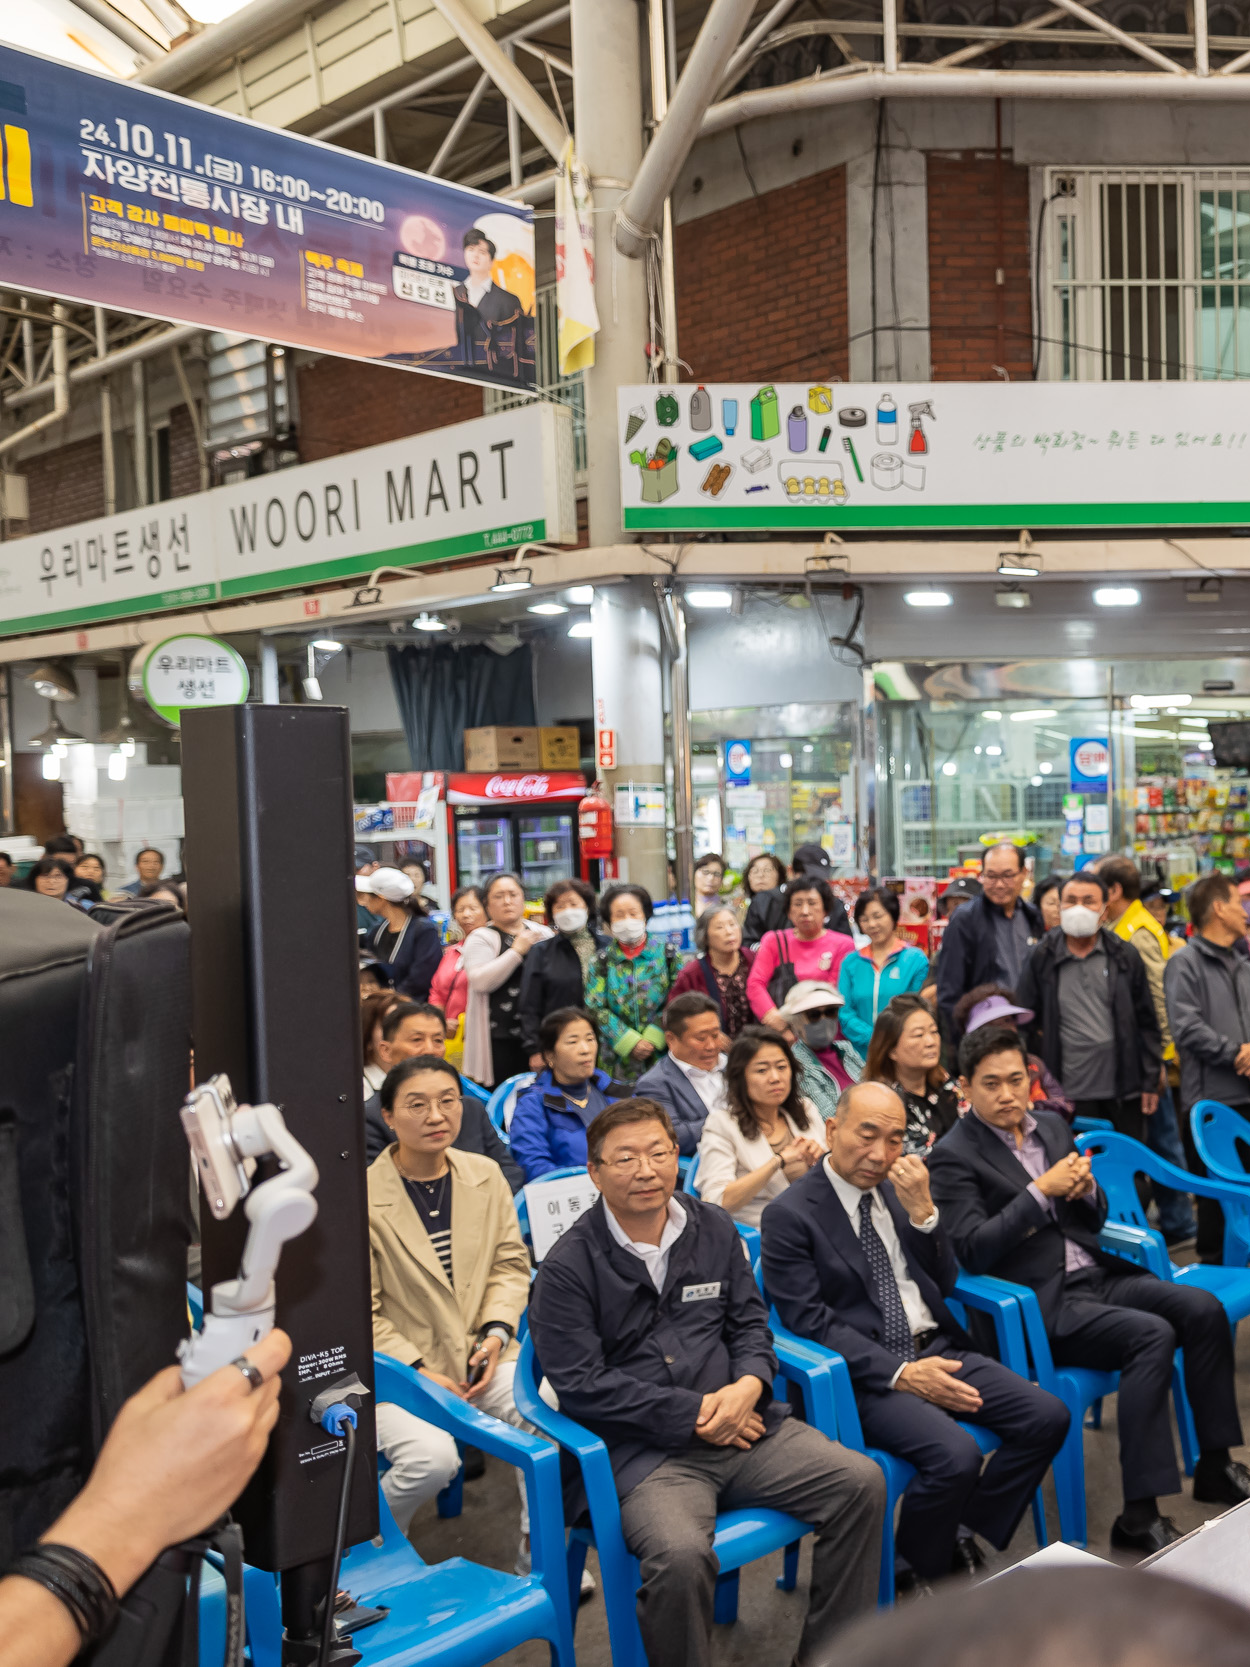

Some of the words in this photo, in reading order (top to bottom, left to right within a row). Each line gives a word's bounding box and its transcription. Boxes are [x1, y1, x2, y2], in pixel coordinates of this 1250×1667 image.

[79, 117, 244, 185] 24.10.11.(금)
[250, 165, 385, 223] 16:00~20:00
[81, 149, 270, 226] 자양전통시장
[276, 202, 304, 236] 내
[89, 194, 124, 218] 고객
[126, 204, 161, 227] 감사
[212, 226, 245, 248] 행사
[229, 477, 361, 556] WOORI
[385, 439, 515, 525] MART
[39, 511, 192, 598] 우리마트생선
[157, 654, 232, 675] 우리마트
[300, 1351, 330, 1363] DIVA-K5
[330, 1345, 345, 1354] TOP
[315, 1370, 331, 1379] INPUT
